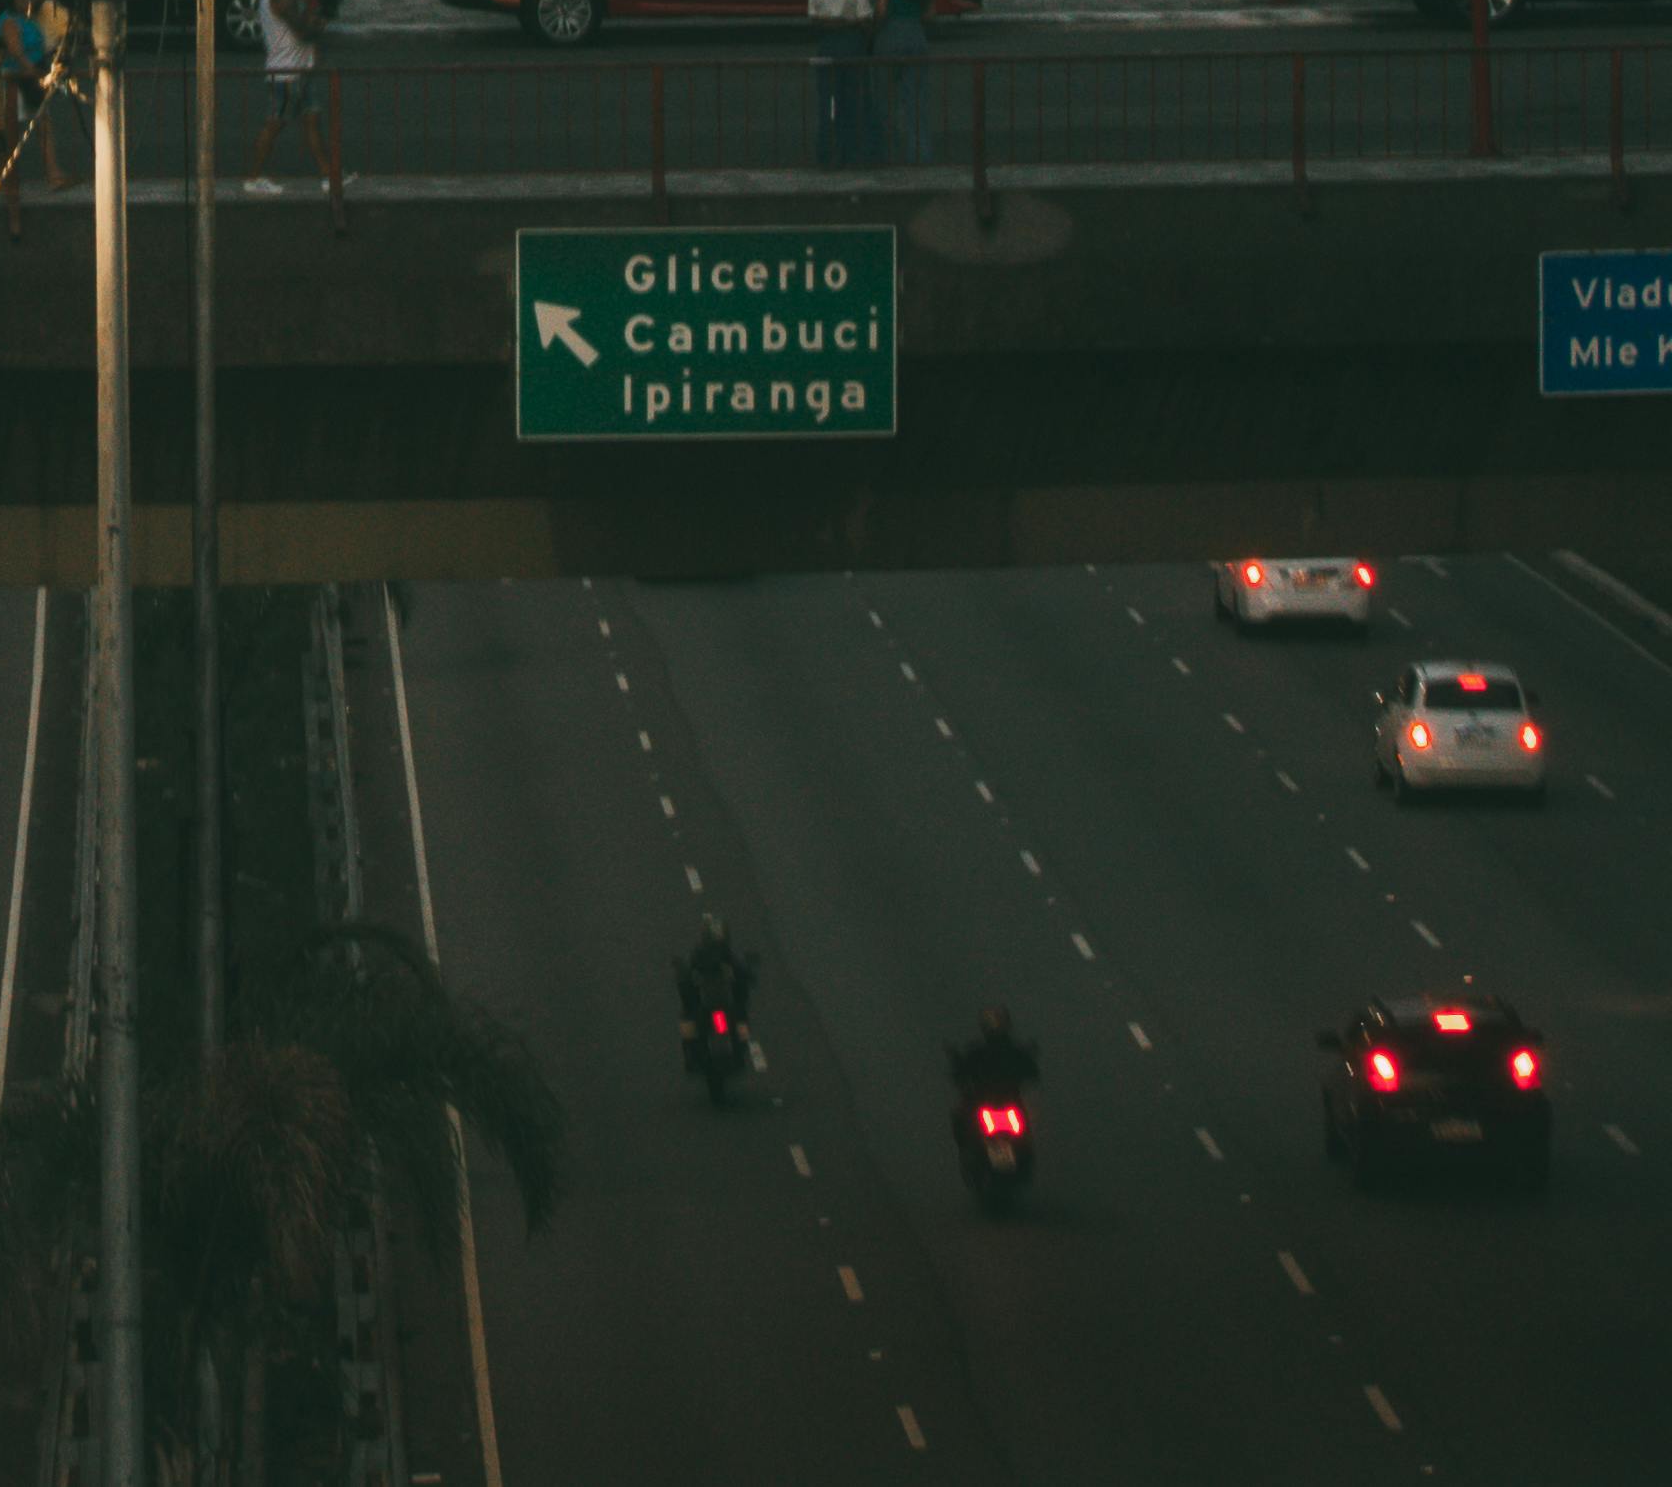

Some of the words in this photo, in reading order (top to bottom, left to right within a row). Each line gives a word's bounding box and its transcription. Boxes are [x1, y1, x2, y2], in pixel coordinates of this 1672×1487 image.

[624, 246, 848, 294] Glicerio
[1571, 277, 1672, 309] Viad
[623, 305, 879, 353] Cambuci
[623, 367, 866, 423] Ipiranga
